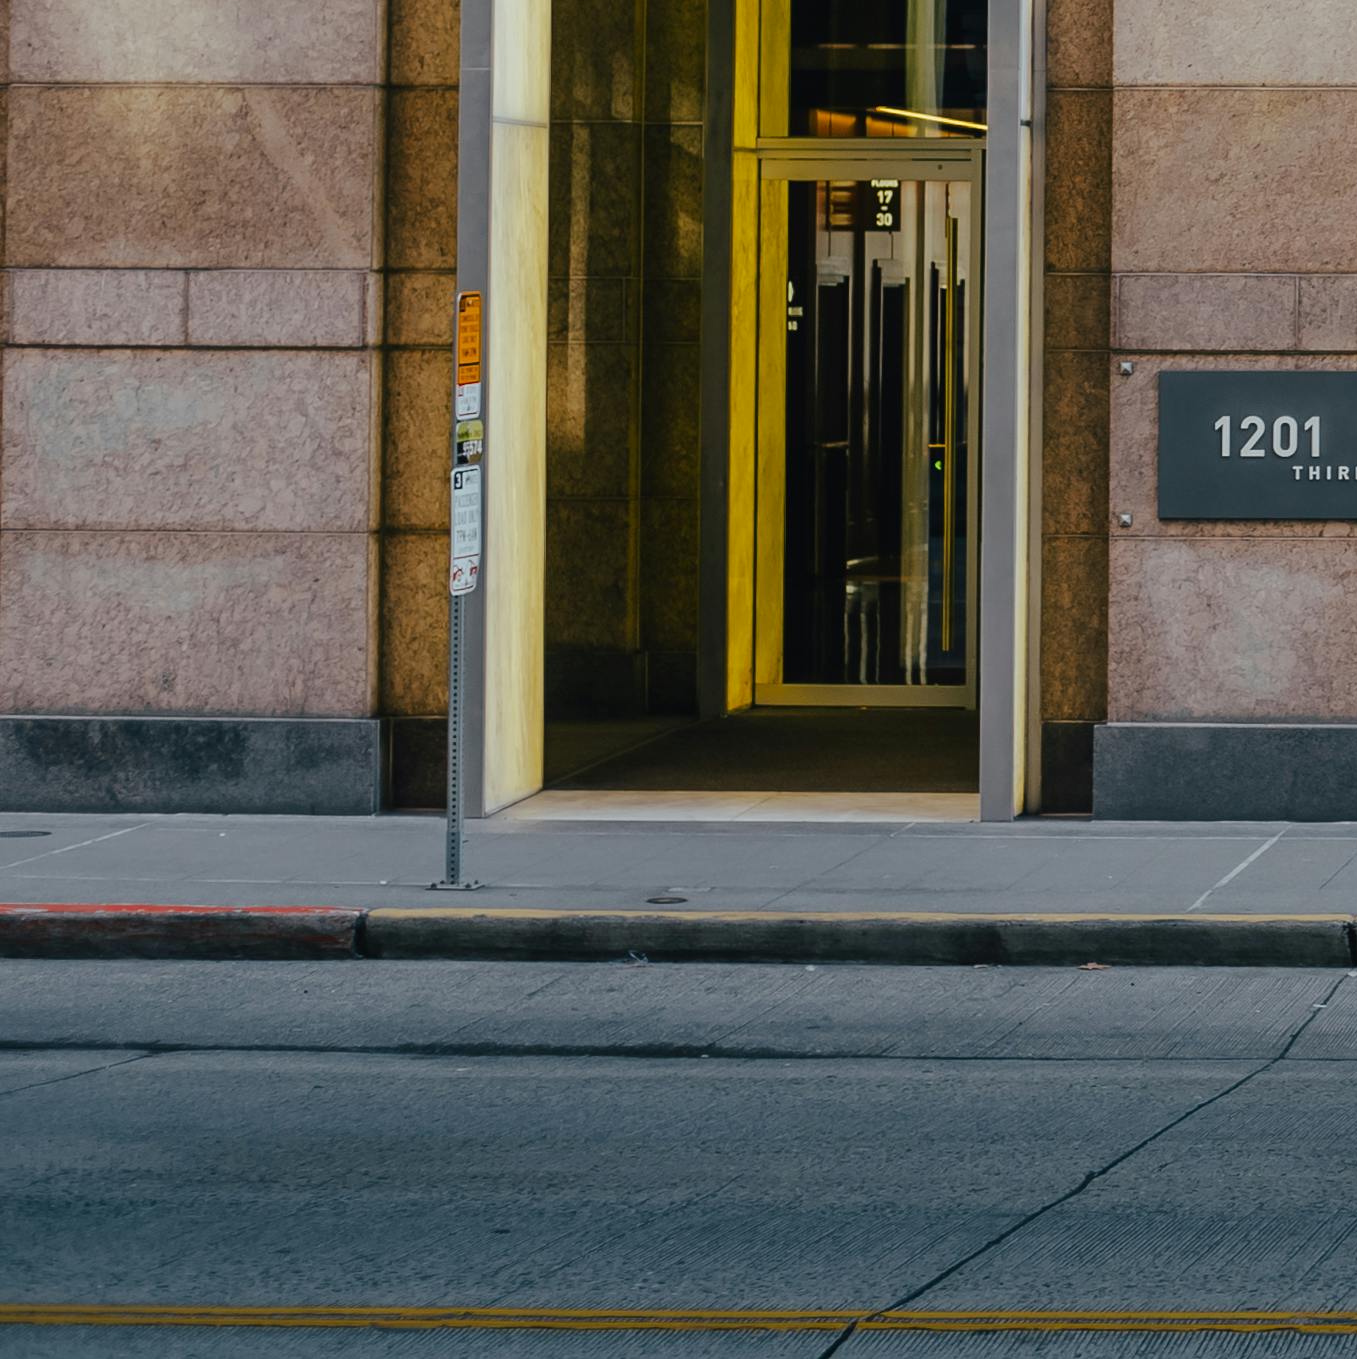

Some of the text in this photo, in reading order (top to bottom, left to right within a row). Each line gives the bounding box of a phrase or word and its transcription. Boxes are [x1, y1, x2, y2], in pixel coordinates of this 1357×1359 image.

[877, 190, 893, 204] 17
[876, 212, 893, 226] 30
[1214, 415, 1321, 458] 1201
